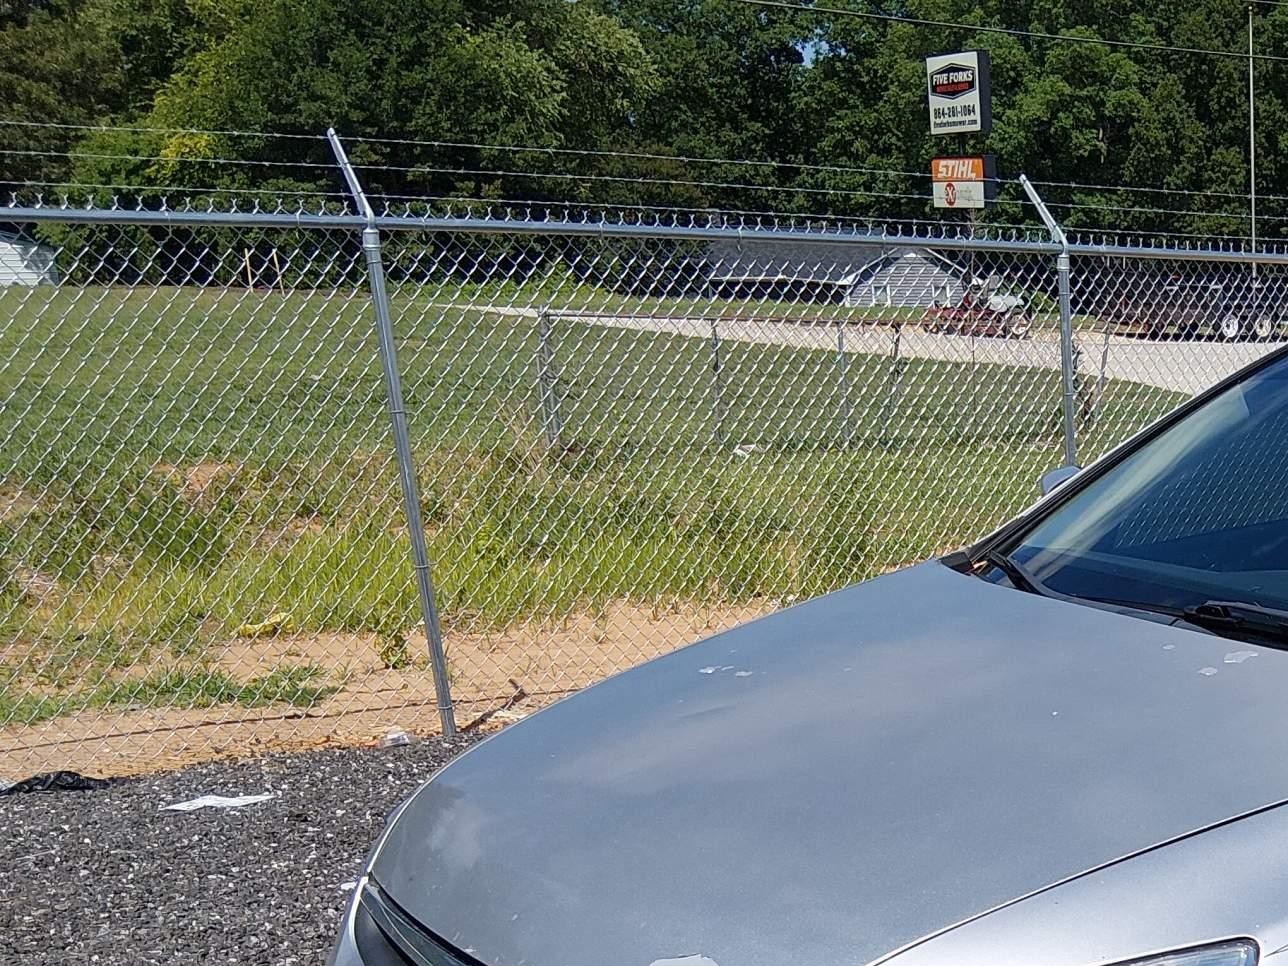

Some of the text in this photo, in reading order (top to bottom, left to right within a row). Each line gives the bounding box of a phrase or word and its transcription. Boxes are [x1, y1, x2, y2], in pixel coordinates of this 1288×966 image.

[933, 70, 973, 86] FIVE FORKS
[937, 159, 976, 179] STIHL
